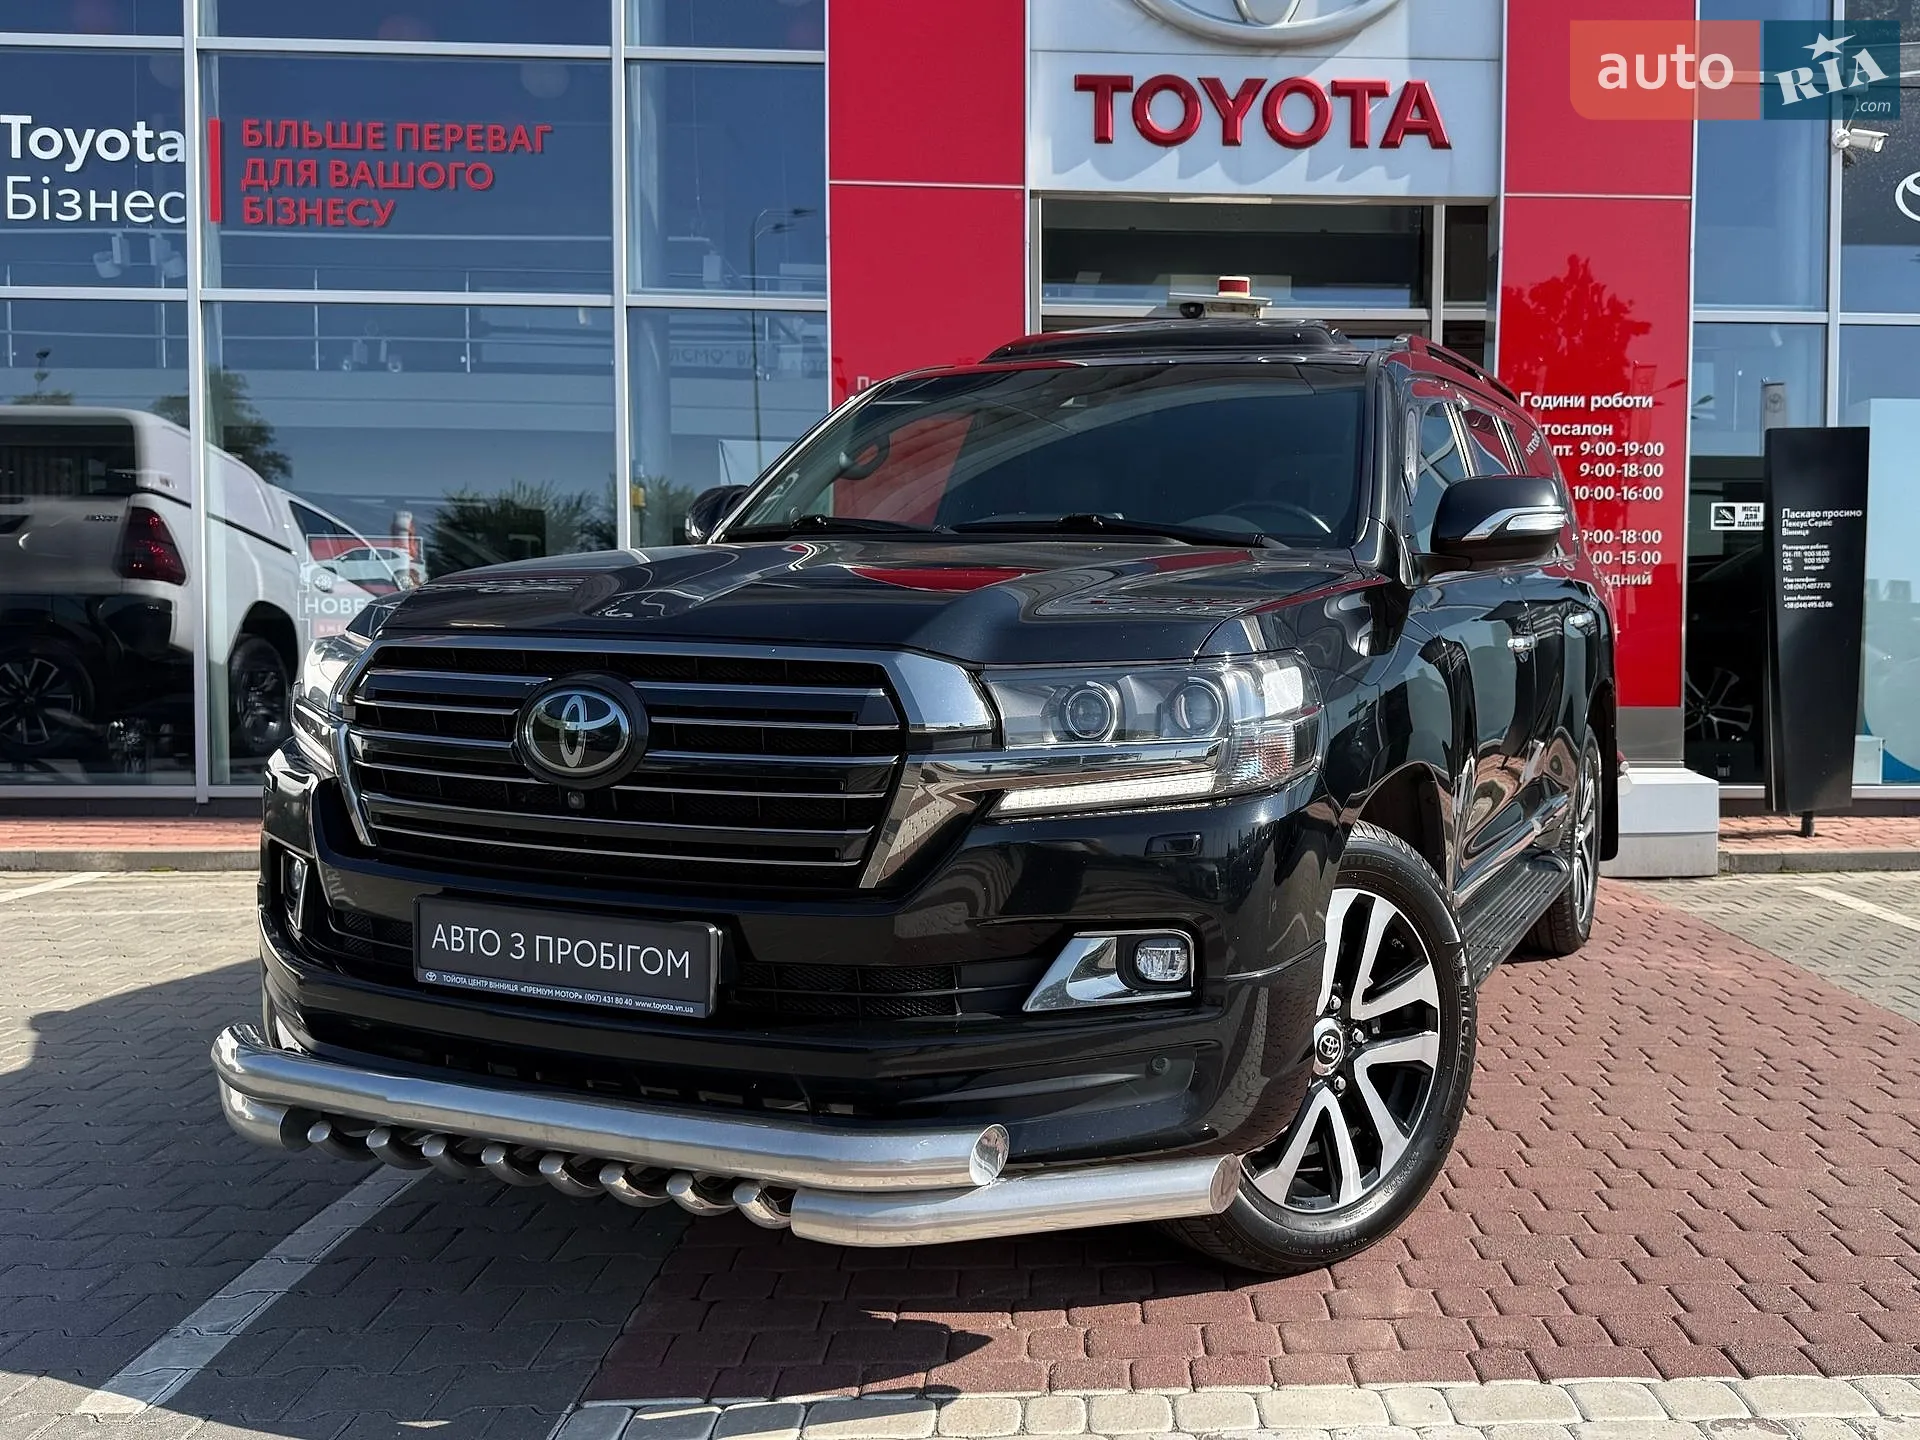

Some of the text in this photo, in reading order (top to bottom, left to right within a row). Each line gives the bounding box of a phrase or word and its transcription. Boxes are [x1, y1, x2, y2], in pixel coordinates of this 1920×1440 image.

[1075, 73, 1453, 150] TOYOTA
[0, 114, 186, 173] Toyota
[242, 119, 552, 153] БІЛЬШЕ ПЕРЕВАГ
[241, 158, 494, 191] ДЛЯ ВАШОГО
[6, 175, 186, 224] Бізнес
[242, 196, 395, 228] БІЗНЕСУ
[1520, 391, 1653, 411] Години роботи
[1539, 423, 1613, 436] тосалон
[1579, 441, 1665, 457] 9:00-19:00
[1579, 462, 1664, 478] 9:00-18:00
[1572, 485, 1663, 501] 10:00-16:00
[1781, 508, 1863, 520] Ласкаво просимо
[431, 923, 690, 979] АВТО З ПРОБІГОМ
[442, 974, 467, 985] ТОЙОТА
[468, 978, 489, 988] ЦЕНТР
[489, 981, 518, 992] ВІННИЦЯ
[584, 993, 602, 1003] (067)
[603, 995, 614, 1004] 431
[615, 996, 624, 1005] 80
[624, 998, 633, 1006] 40
[634, 999, 694, 1014] www.toyota.vn.ua
